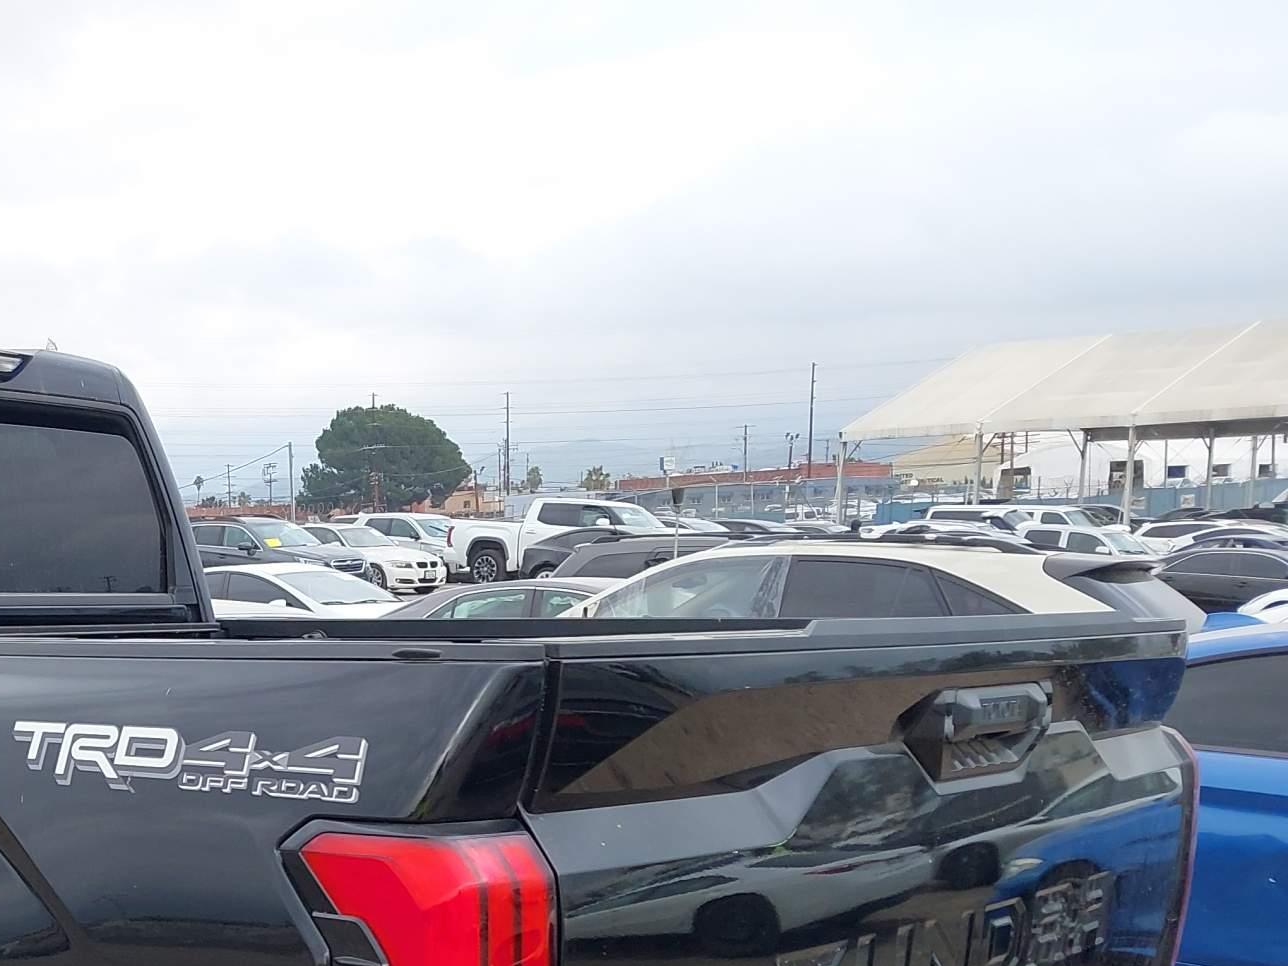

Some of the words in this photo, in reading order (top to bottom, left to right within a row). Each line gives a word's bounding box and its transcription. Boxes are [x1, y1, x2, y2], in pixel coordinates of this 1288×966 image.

[13, 720, 186, 792] TRD
[178, 771, 249, 794] OFF
[251, 777, 360, 804] ROAD
